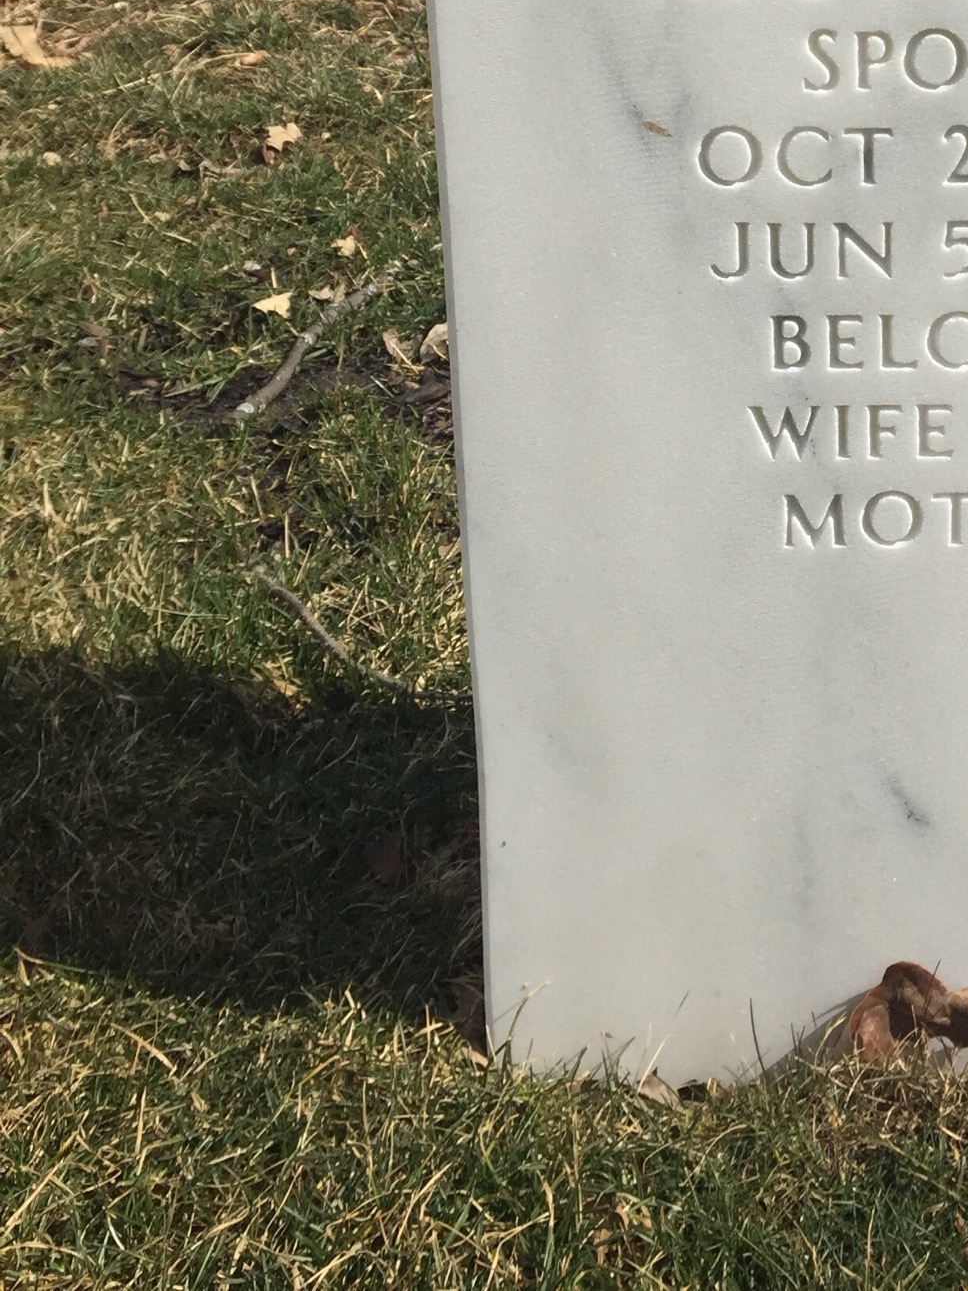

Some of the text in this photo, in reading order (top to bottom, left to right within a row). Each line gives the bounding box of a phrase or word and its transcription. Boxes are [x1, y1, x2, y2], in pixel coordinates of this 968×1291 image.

[698, 124, 893, 187] OCT
[710, 220, 894, 280] JUN
[747, 404, 954, 461] WIFE
